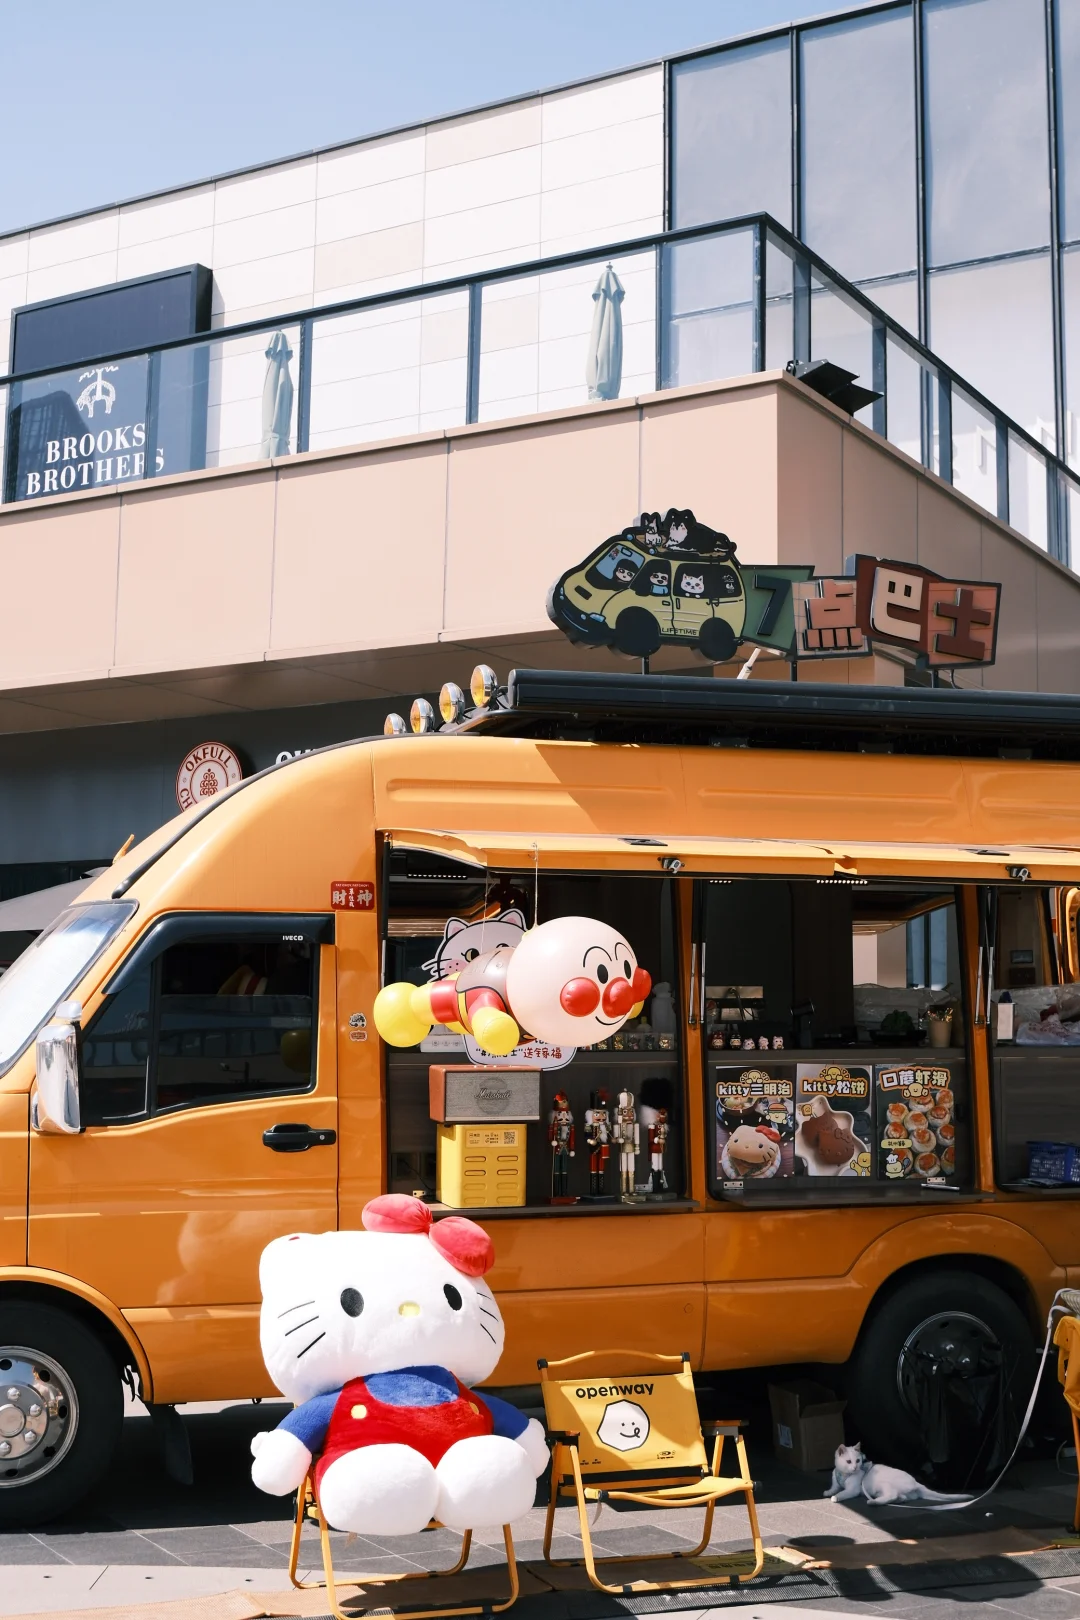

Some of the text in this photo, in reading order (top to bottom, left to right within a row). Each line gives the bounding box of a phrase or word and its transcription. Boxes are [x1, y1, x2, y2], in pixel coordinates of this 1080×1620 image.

[46, 423, 145, 463] BROOKS
[26, 448, 164, 495] BROTHERS
[754, 566, 991, 661] 7点巴士
[661, 627, 697, 636] LIFETIME
[185, 746, 229, 772] OKFULL
[803, 1080, 866, 1095] kitty松饼
[882, 1070, 947, 1088] 口蘑虾滑
[719, 1083, 791, 1097] kitty三明治
[575, 1383, 654, 1399] openway
